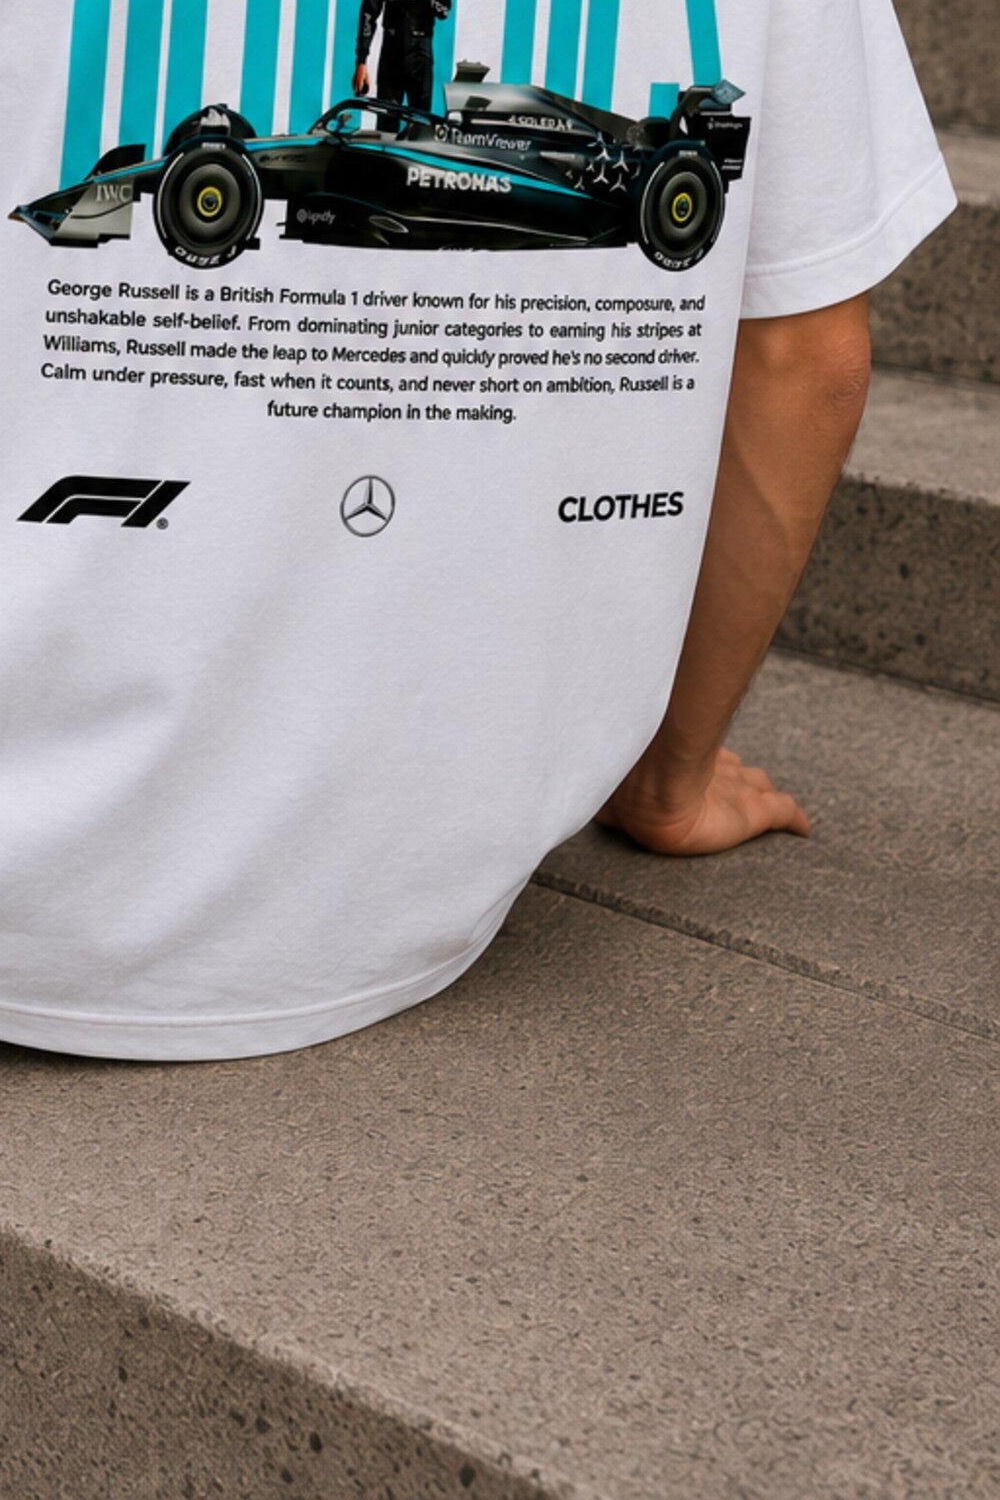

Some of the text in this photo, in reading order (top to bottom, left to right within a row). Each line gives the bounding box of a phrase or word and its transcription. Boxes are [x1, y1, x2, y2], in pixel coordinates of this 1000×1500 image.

[406, 166, 513, 194] PETRONAS
[47, 278, 706, 315] George Russell is a British Formula 1 driver known for his precision, composure, and
[45, 307, 147, 328] unshakable
[152, 311, 242, 331] self-belief.
[247, 315, 291, 333] From
[296, 316, 389, 339] dominating
[391, 318, 441, 339] junior
[443, 321, 523, 342] categories
[528, 323, 545, 338] to
[610, 321, 632, 339] his
[636, 321, 684, 341] stripes
[687, 322, 703, 338] at
[42, 334, 122, 357] Williams,
[126, 338, 187, 357] Russell
[189, 341, 238, 359] made
[241, 343, 270, 360] the
[272, 344, 308, 365] leap
[310, 346, 329, 362] to
[331, 346, 407, 364] Mercedes
[409, 348, 439, 365] and
[497, 349, 550, 370] proved
[551, 349, 581, 366] he's
[583, 352, 603, 366] no
[604, 348, 656, 366] second
[657, 347, 700, 365] driver.
[40, 362, 696, 395] Calm under pressure, fast when it counts, and never short on ambition, Russell is a
[266, 399, 517, 425] future champion in the making.
[557, 491, 685, 523] CLOTHES
